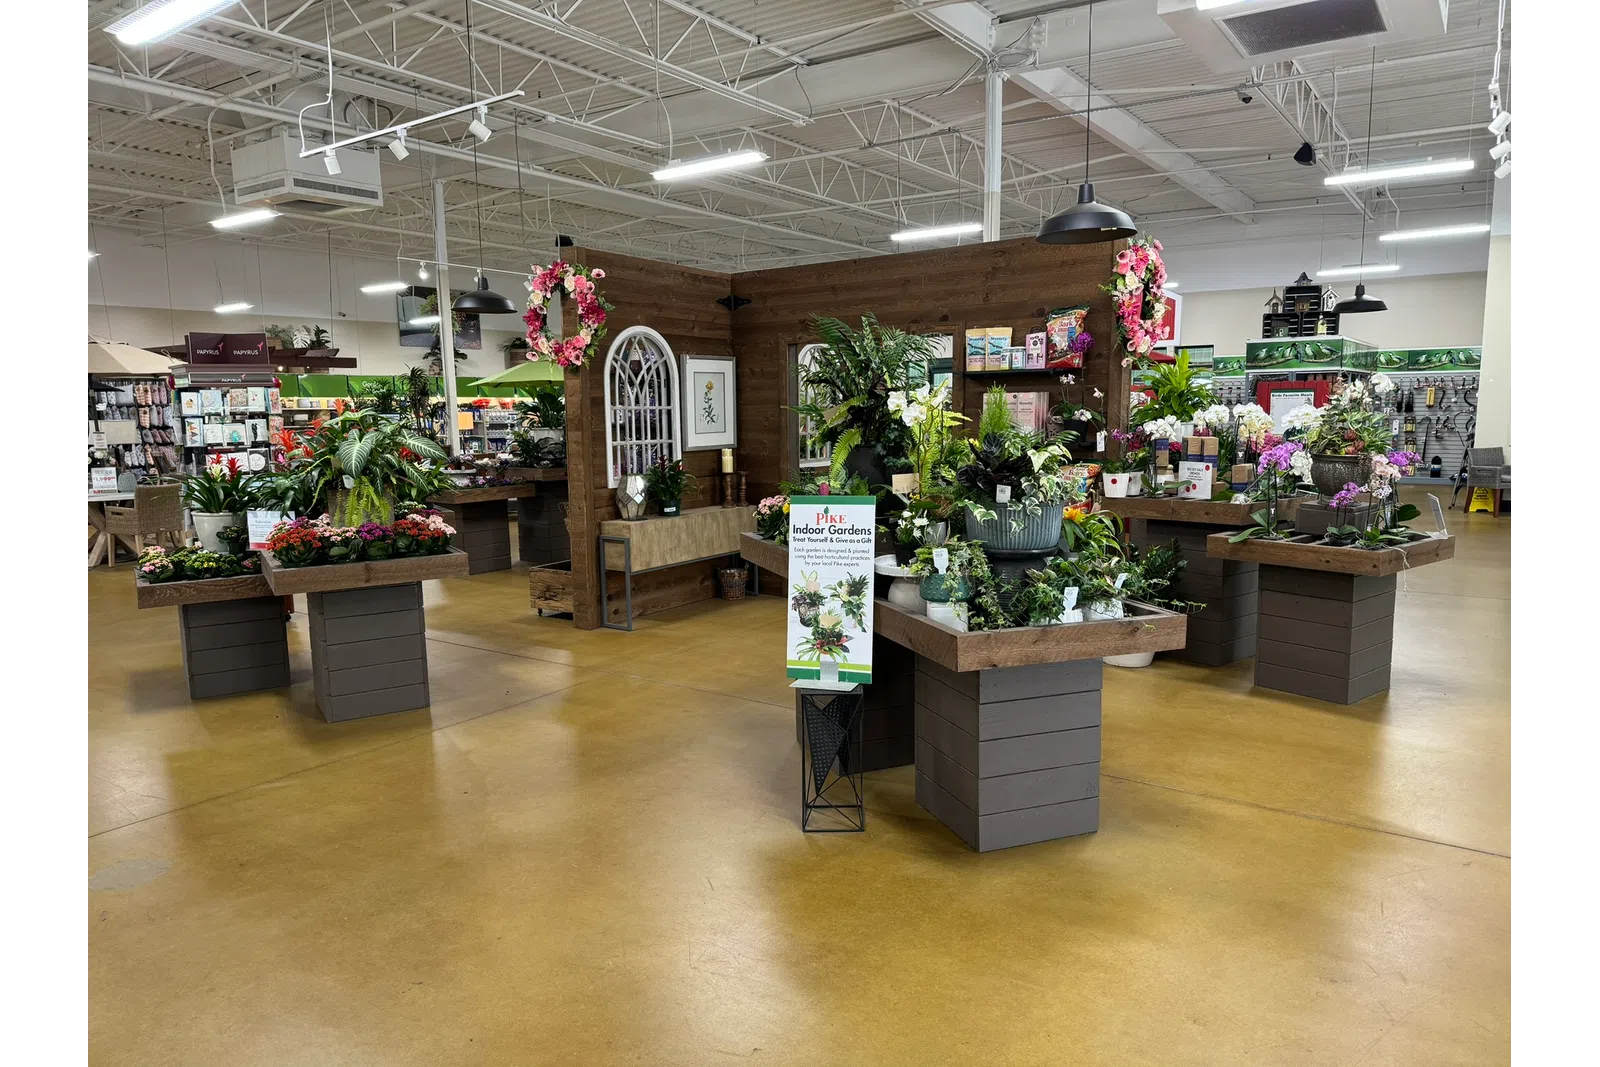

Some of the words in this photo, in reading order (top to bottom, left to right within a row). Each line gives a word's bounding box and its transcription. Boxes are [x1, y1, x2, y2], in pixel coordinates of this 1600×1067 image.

[816, 511, 847, 525] PIKE
[793, 524, 825, 535] Indoor
[828, 524, 872, 535] Gardens
